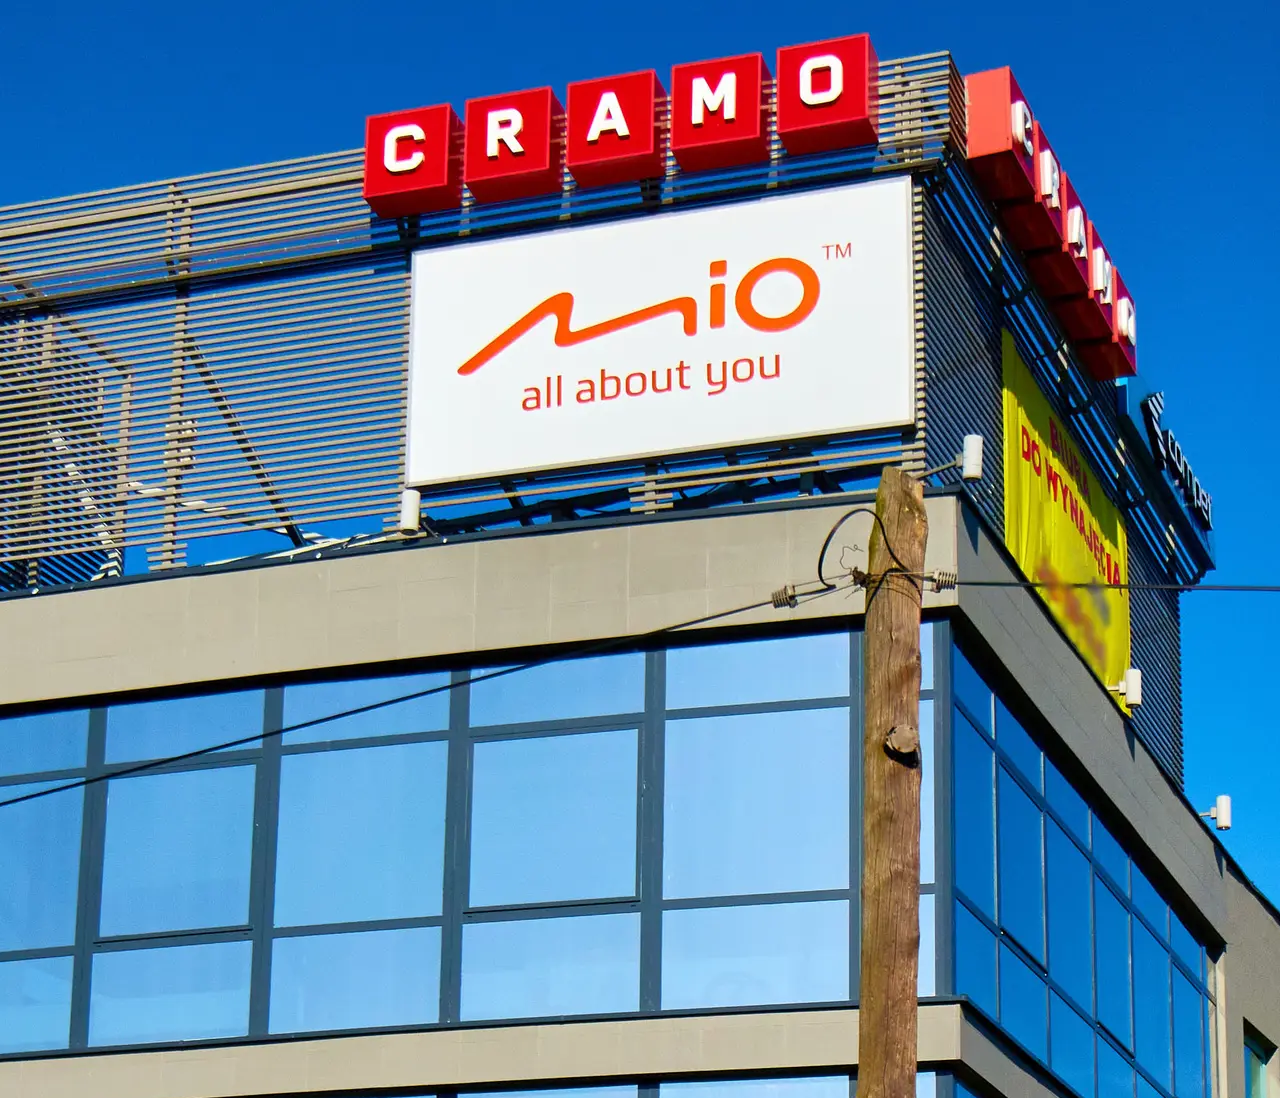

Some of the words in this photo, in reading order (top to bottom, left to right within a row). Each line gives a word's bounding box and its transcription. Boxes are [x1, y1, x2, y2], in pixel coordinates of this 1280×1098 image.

[383, 54, 845, 174] CRAMO
[521, 375, 562, 411] all
[576, 359, 691, 403] about
[706, 353, 781, 395] you
[1021, 425, 1041, 477] DO
